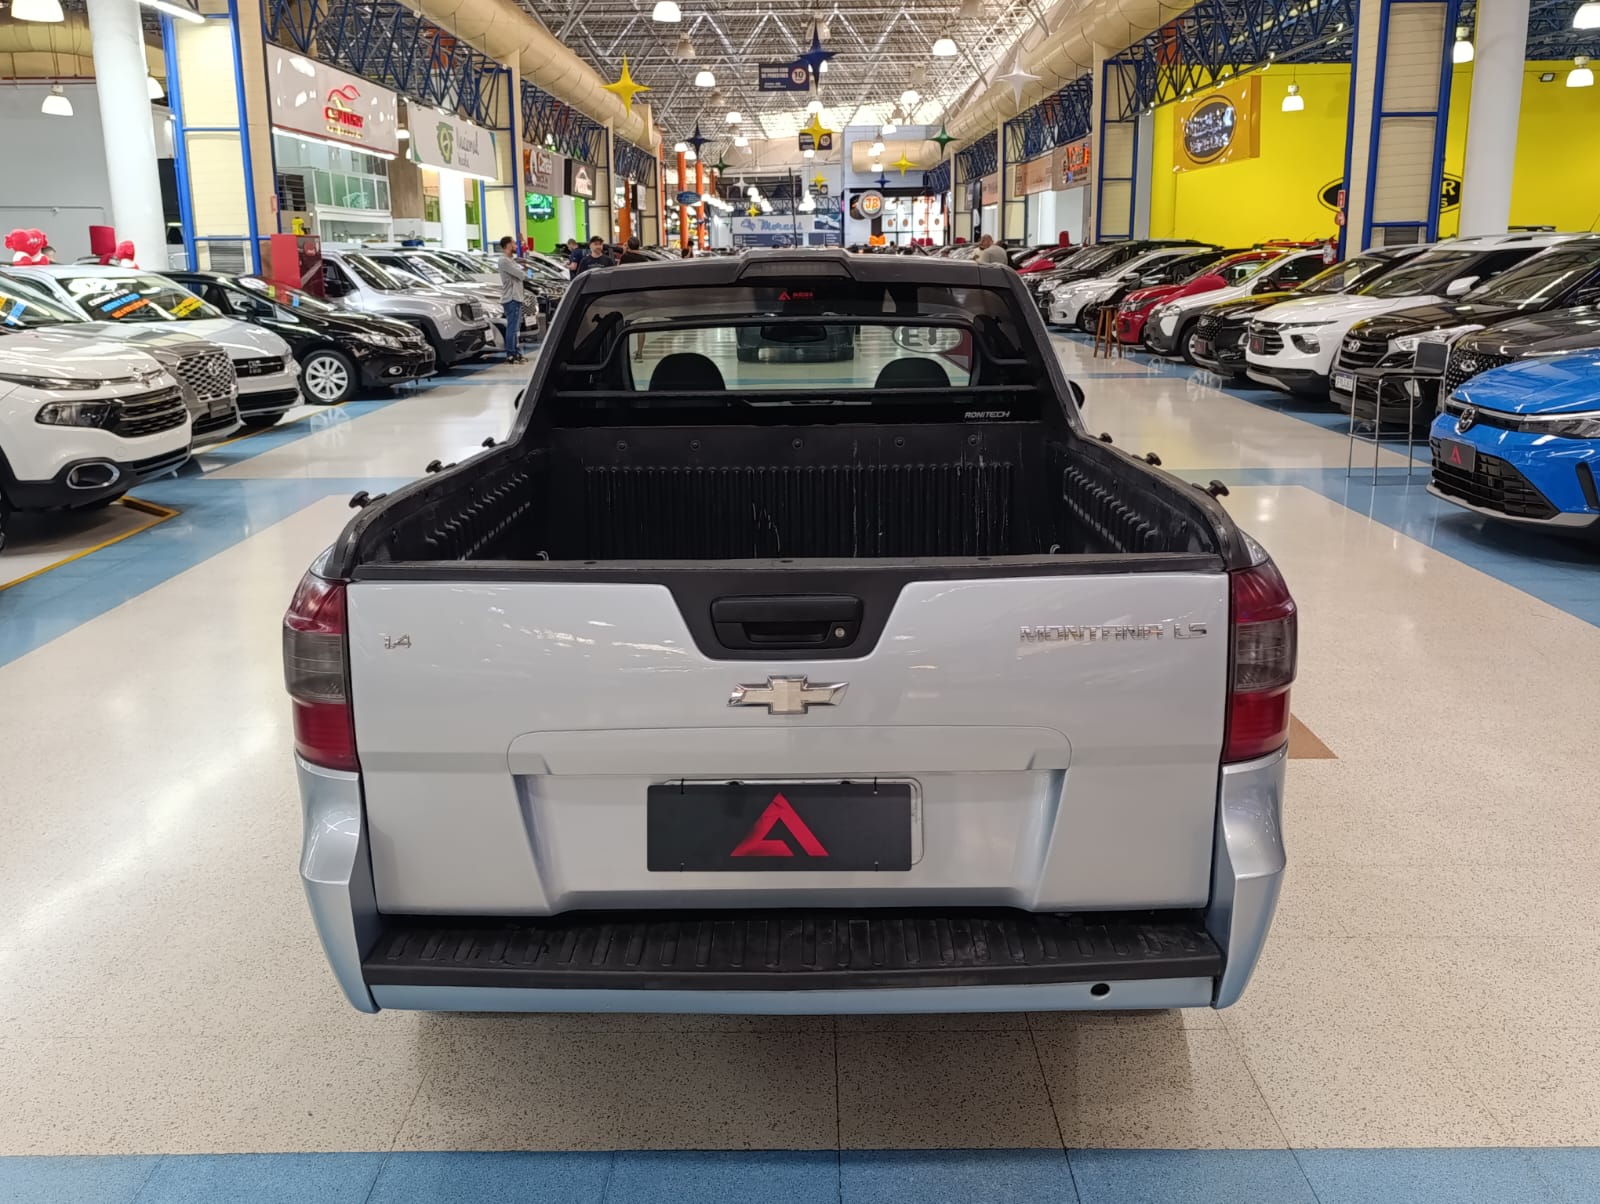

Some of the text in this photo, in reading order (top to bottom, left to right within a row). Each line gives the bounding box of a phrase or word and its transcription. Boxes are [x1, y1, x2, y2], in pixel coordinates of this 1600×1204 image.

[964, 410, 1010, 419] RONITECH
[1020, 622, 1207, 642] MONTANA LS
